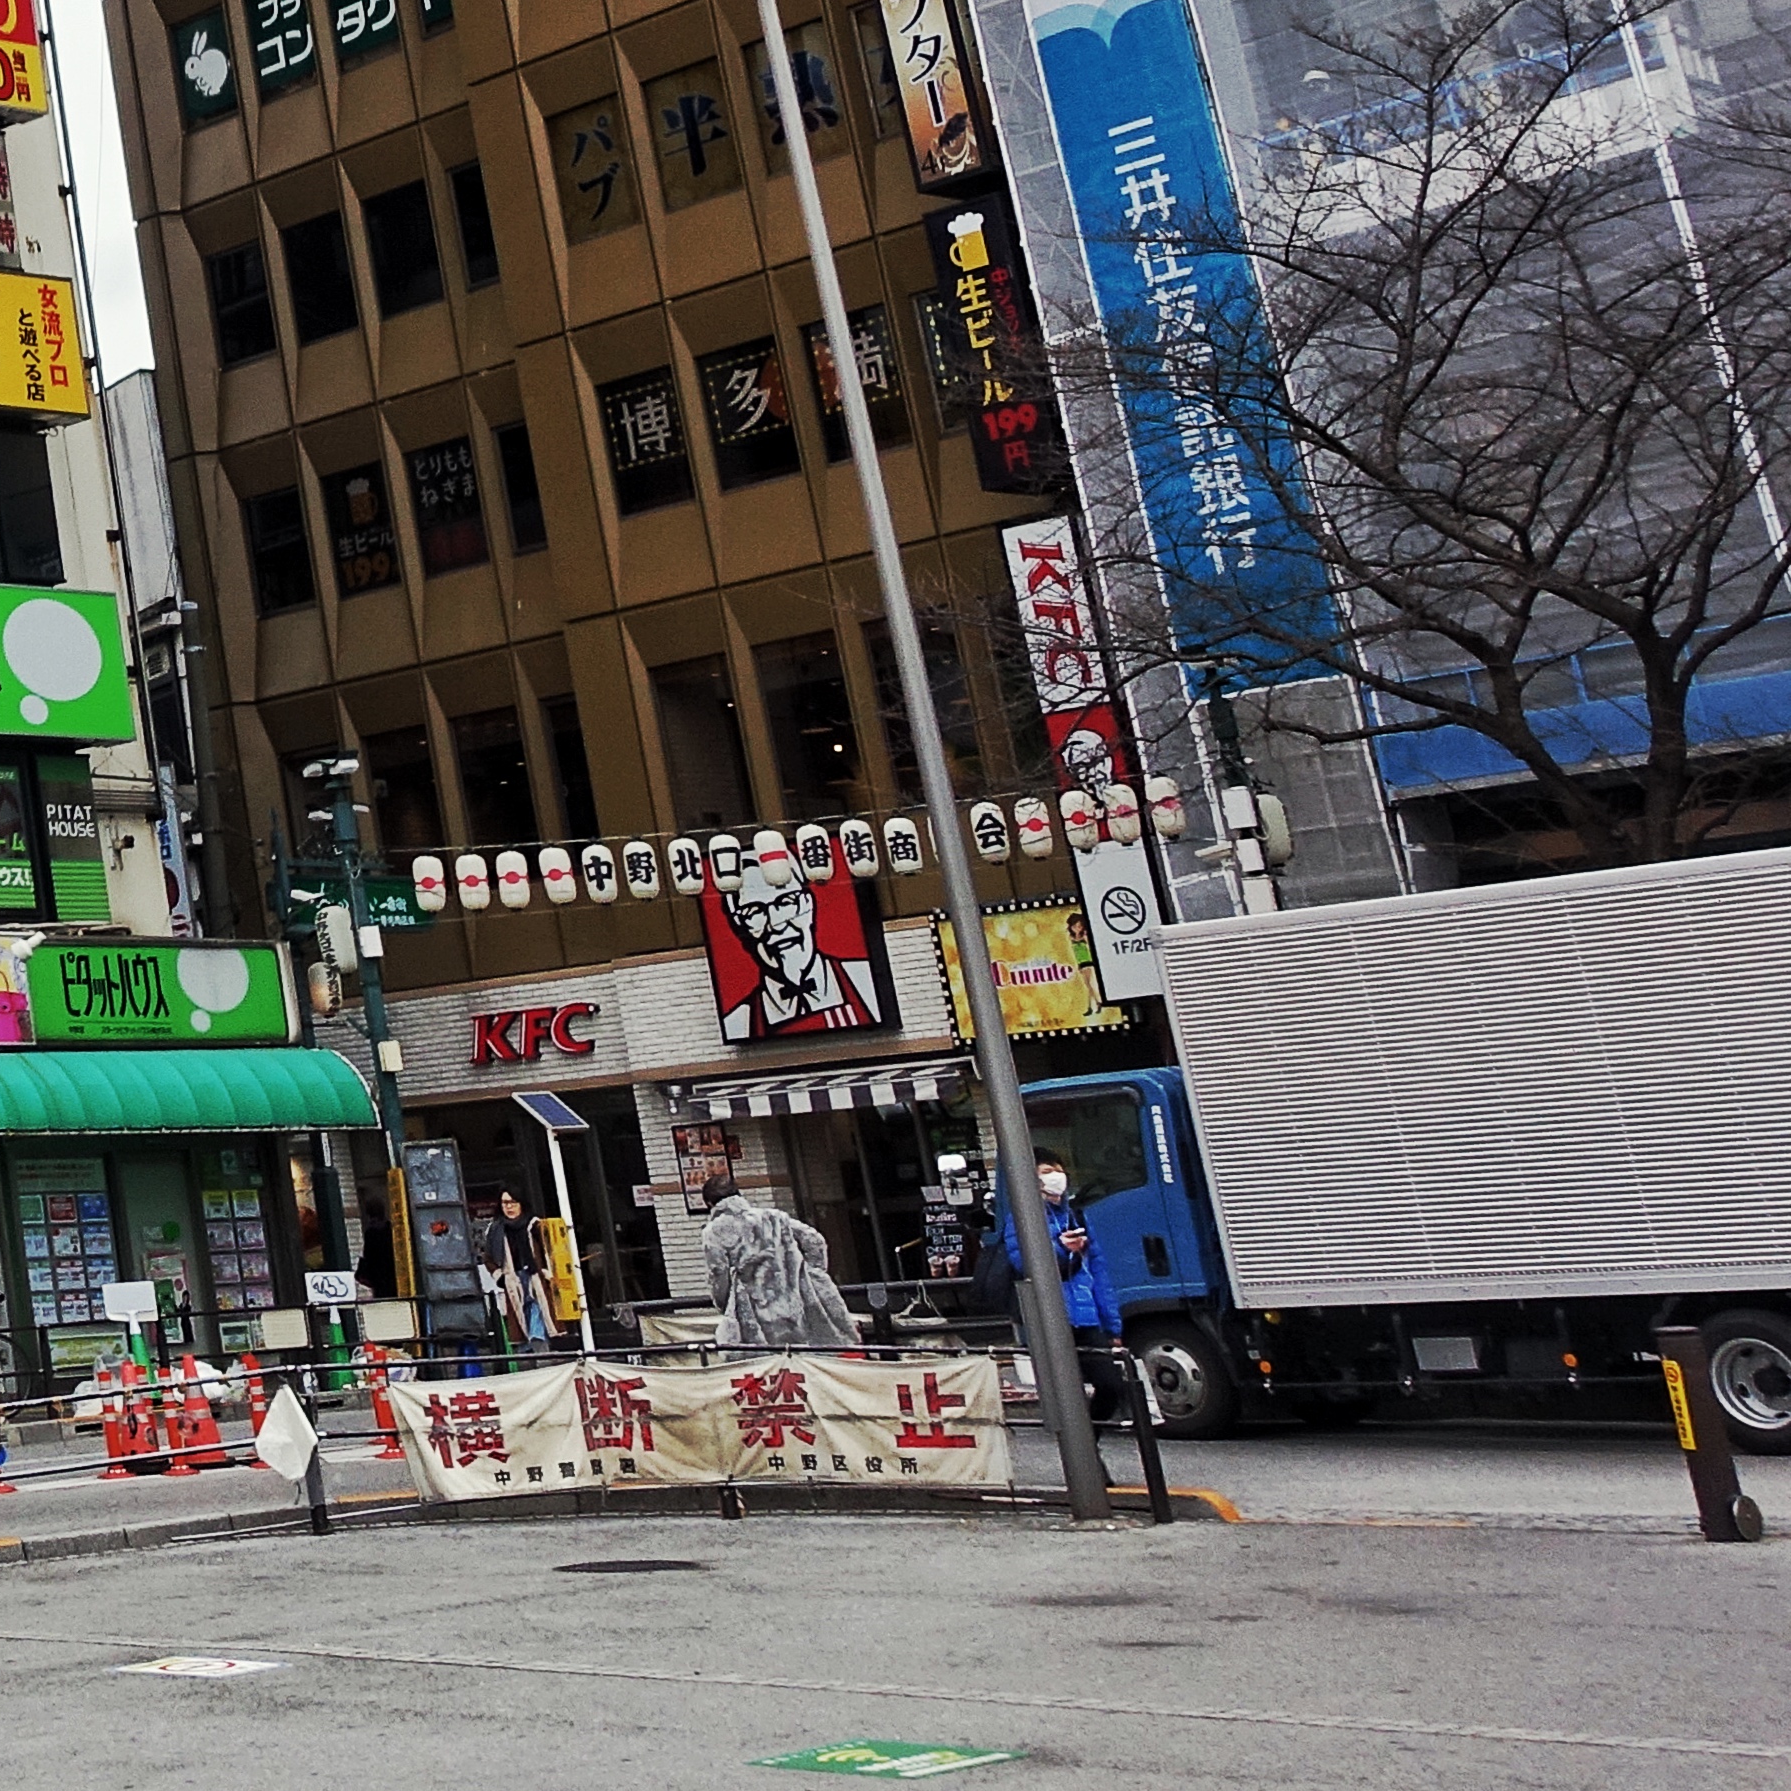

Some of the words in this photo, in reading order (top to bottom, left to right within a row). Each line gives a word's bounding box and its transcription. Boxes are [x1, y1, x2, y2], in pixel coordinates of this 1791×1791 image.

[571, 114, 621, 222] パブ
[18, 308, 46, 403] と遊べる店
[37, 284, 69, 388] 女流プロ
[339, 530, 396, 558] 生ビール
[1016, 539, 1095, 689] KFC
[46, 804, 92, 820] PITAT
[49, 822, 96, 838] HOUSE
[60, 952, 171, 1019] ピタットハウス
[470, 1003, 601, 1065] KFC
[423, 1369, 977, 1470] 横断禁止
[493, 1455, 640, 1487] 中野警察署
[767, 1452, 920, 1476] 中野区役所
